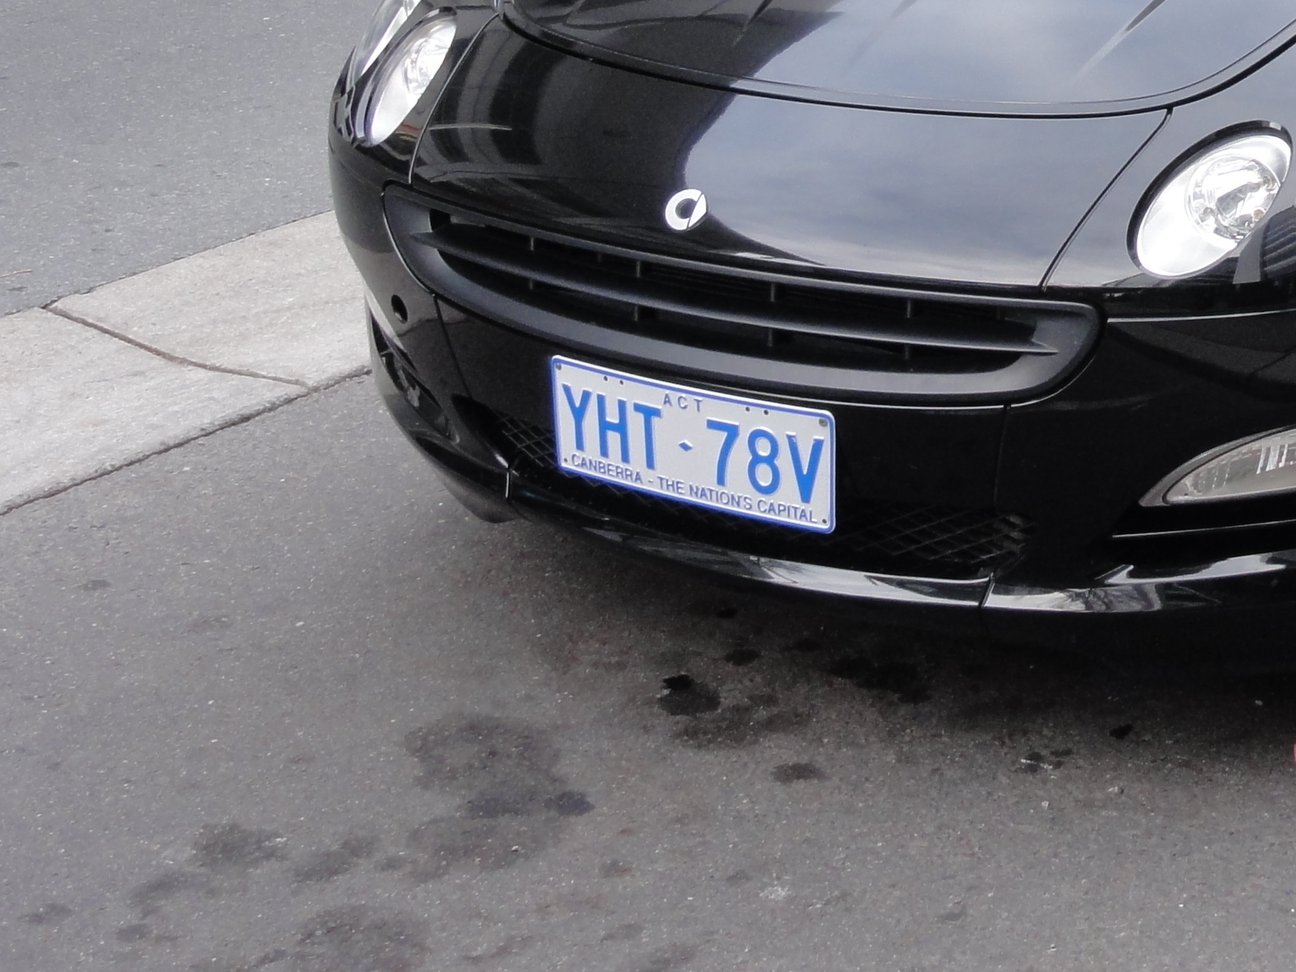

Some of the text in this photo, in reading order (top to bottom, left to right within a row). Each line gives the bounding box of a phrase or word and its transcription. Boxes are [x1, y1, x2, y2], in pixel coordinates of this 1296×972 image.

[662, 393, 703, 413] ACT
[561, 383, 825, 505] YHT 78V
[571, 453, 643, 484] CANBERRA
[657, 475, 685, 494] THE
[756, 498, 818, 524] CAPITAL
